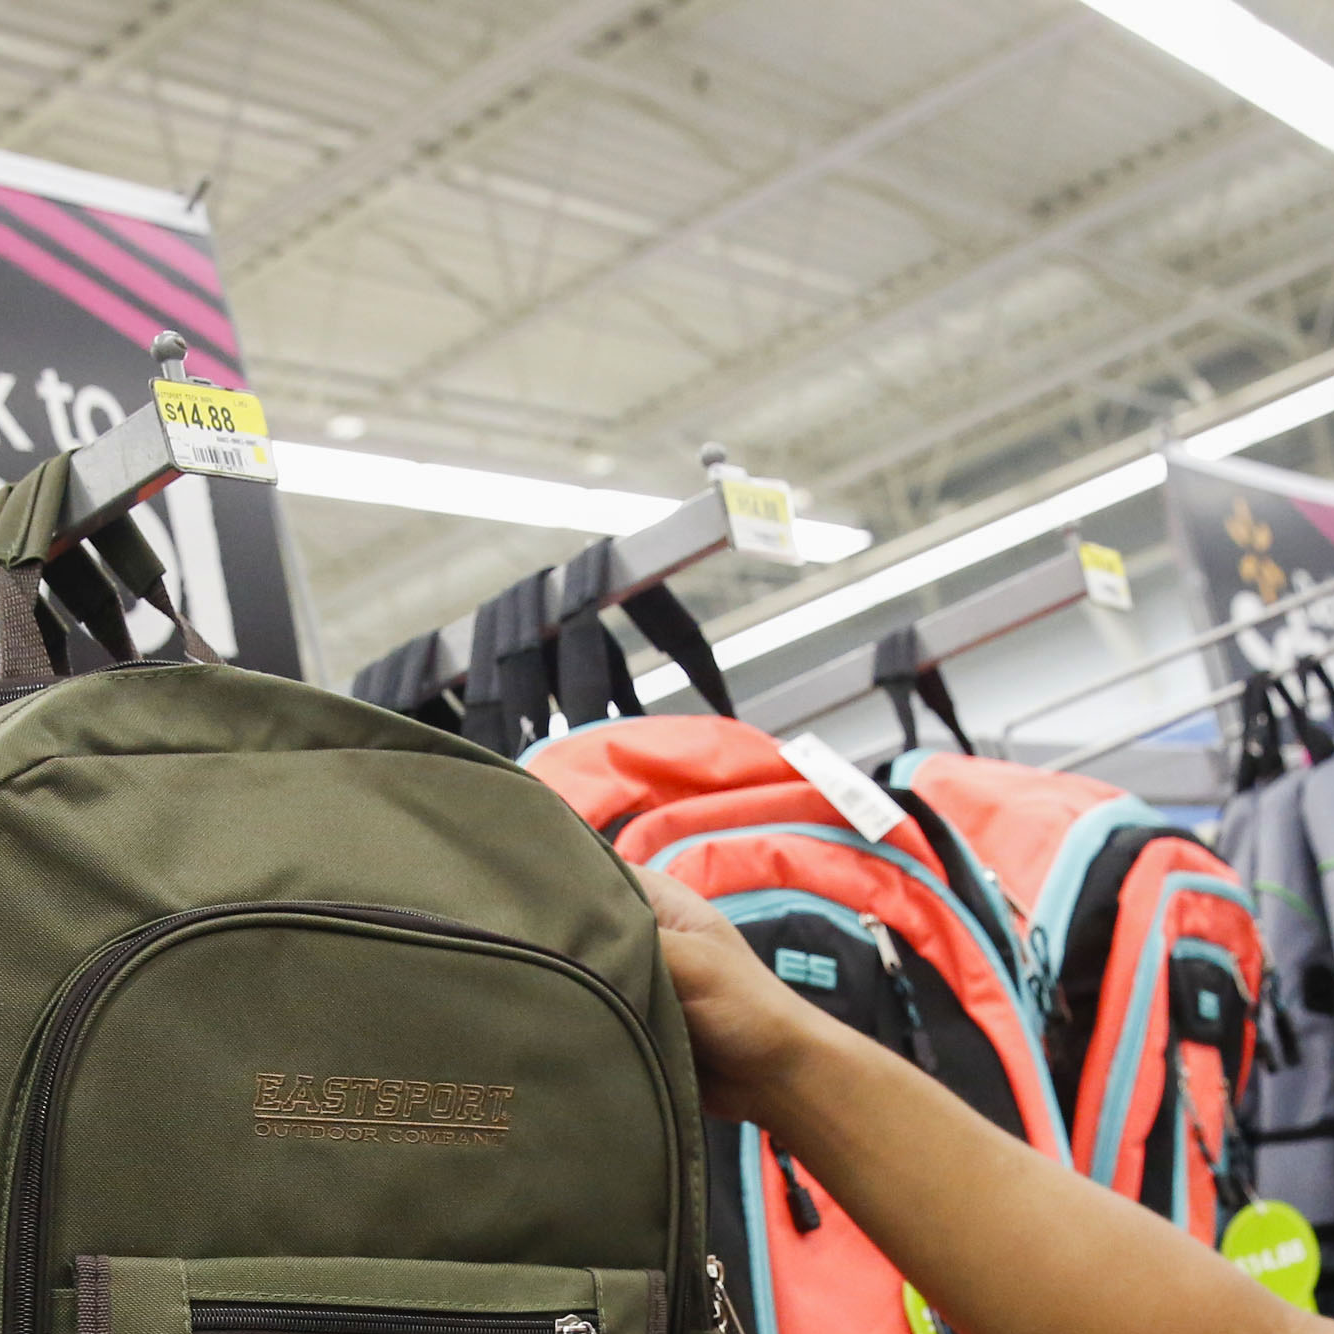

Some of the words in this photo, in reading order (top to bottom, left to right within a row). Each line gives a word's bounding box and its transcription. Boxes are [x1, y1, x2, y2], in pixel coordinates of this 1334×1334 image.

[35, 367, 127, 454] to
[165, 401, 236, 433] $14.88
[253, 1072, 514, 1123] EASTSPORT
[254, 1122, 379, 1143] OUTDOOR
[387, 1128, 505, 1148] COMPANY
